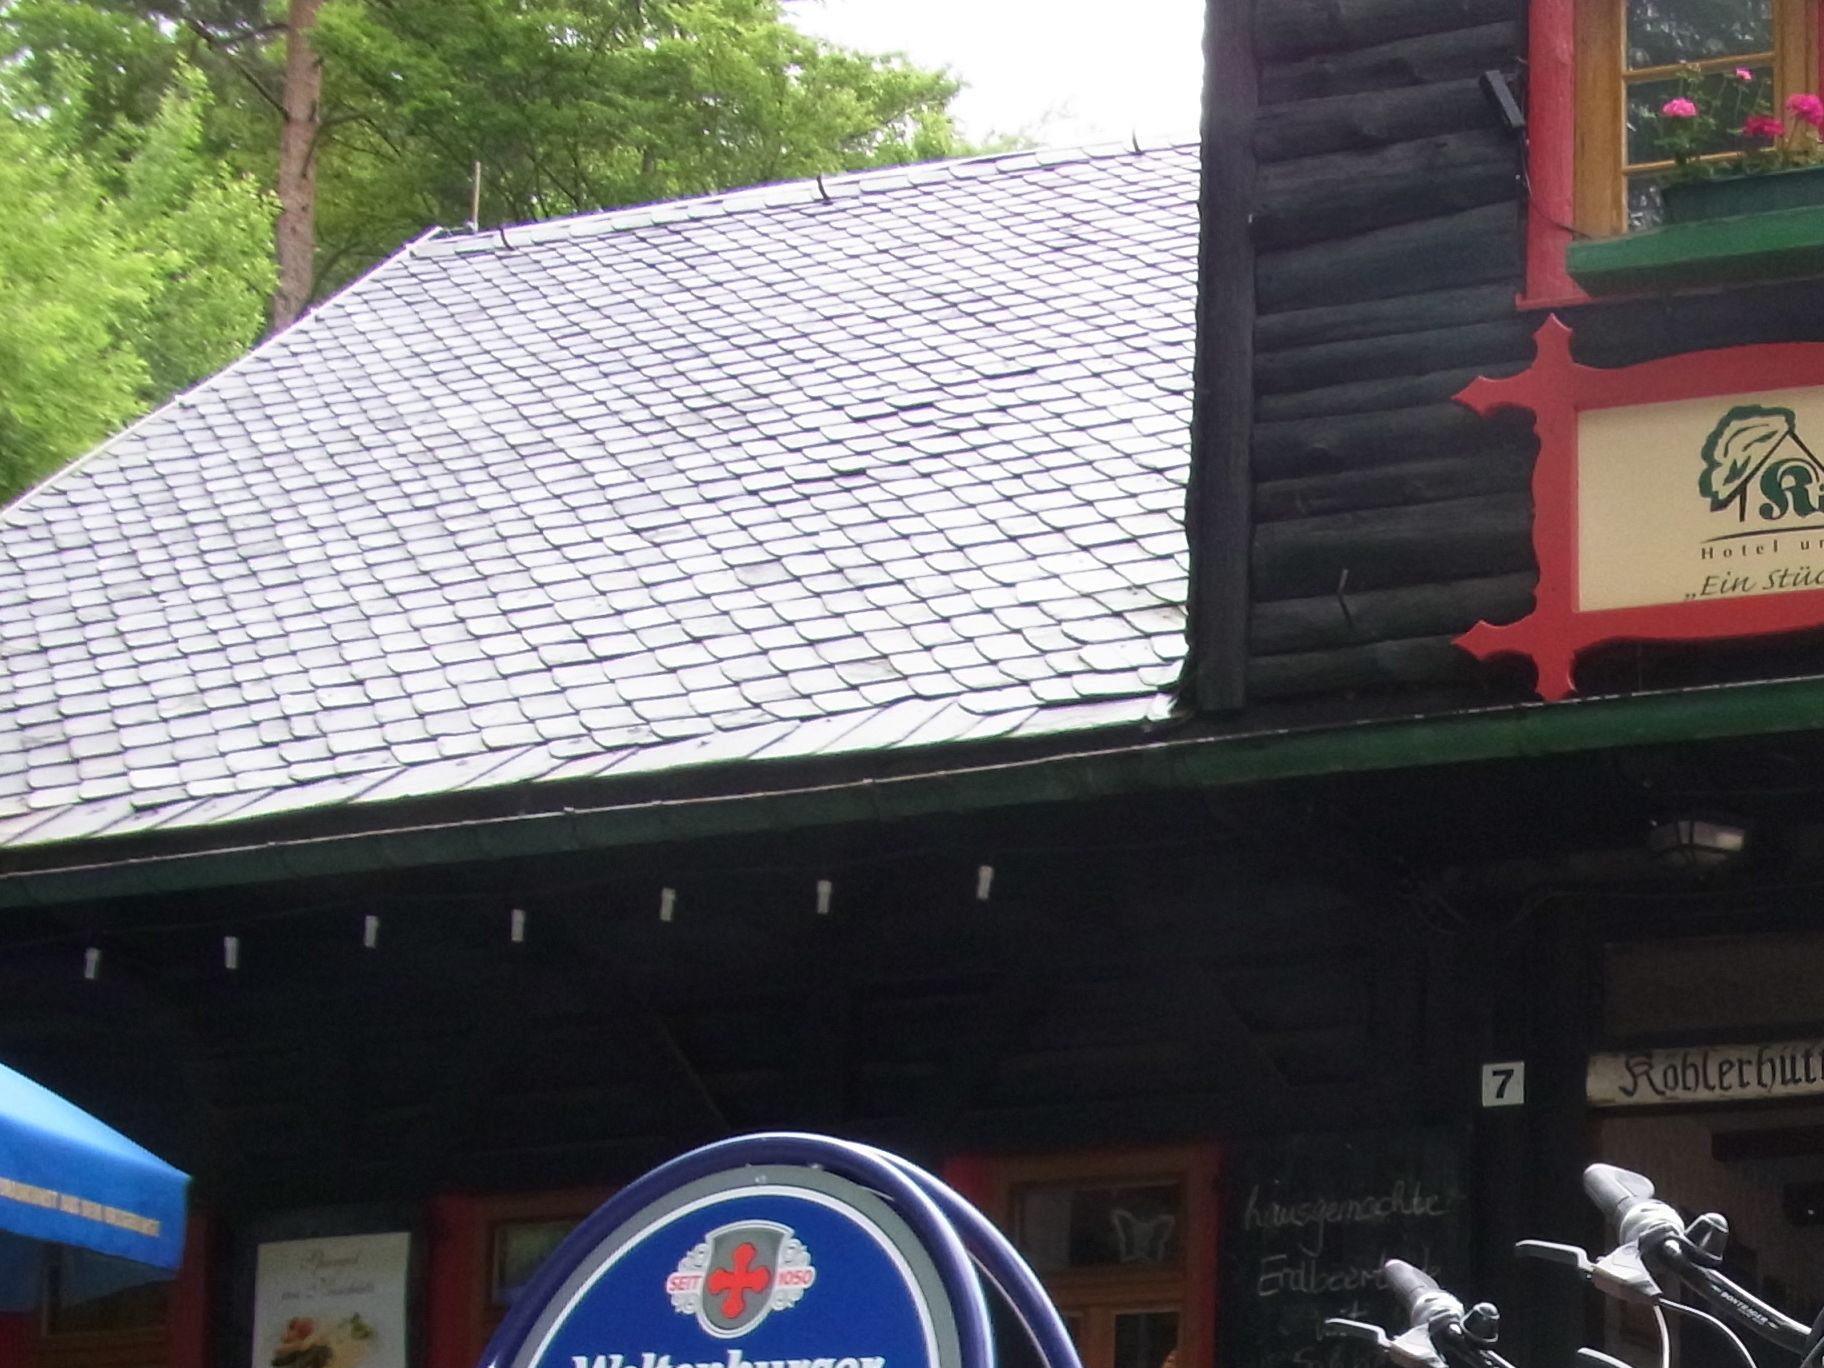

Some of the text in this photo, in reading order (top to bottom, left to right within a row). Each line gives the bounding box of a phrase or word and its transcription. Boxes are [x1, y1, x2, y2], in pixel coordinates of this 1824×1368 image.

[1701, 539, 1779, 560] Hotel
[1491, 1069, 1515, 1100] 7
[668, 1270, 812, 1291] SEIT 1050
